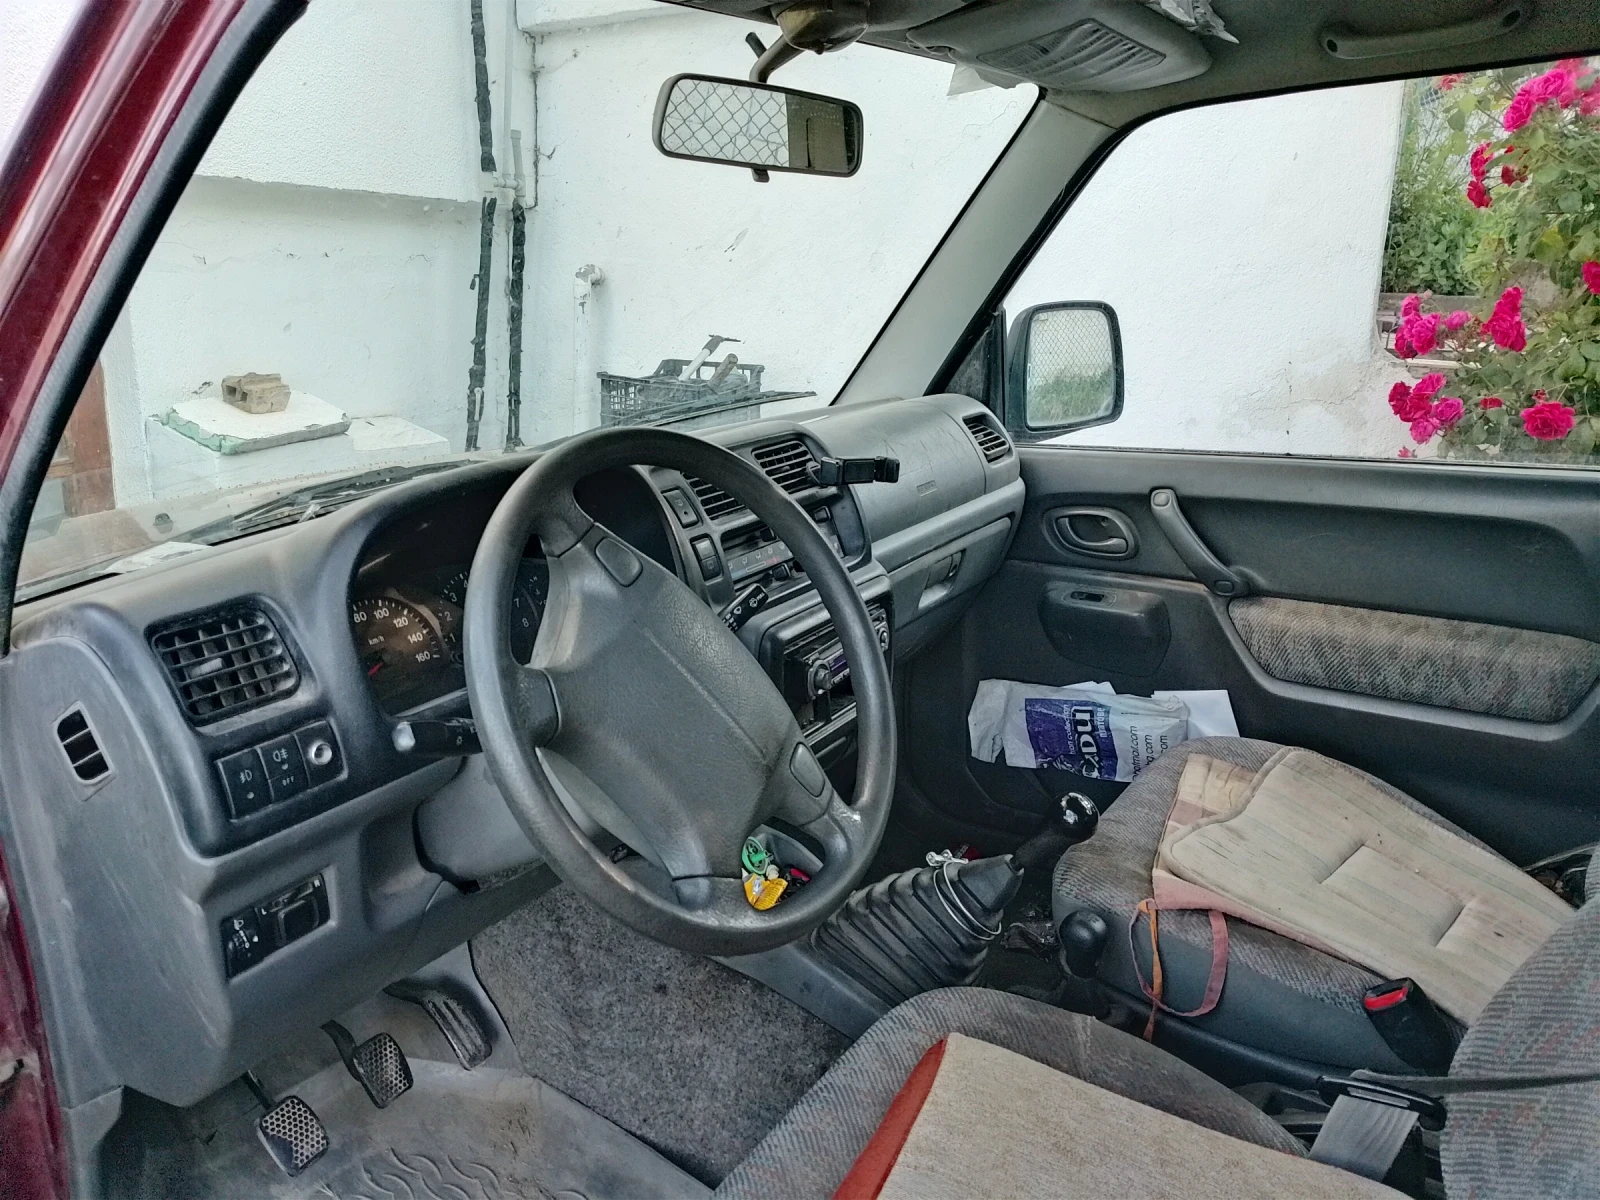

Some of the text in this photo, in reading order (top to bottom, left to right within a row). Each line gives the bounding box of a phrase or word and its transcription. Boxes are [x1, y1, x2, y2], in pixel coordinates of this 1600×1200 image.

[450, 592, 458, 602] 3
[513, 598, 519, 608] 7
[353, 611, 367, 623] 80
[373, 607, 390, 620] 100
[444, 611, 452, 622] 2
[393, 616, 409, 628] 120
[521, 617, 530, 628] 8
[368, 635, 385, 646] km/h
[407, 632, 424, 645] 140
[415, 651, 431, 663] 160
